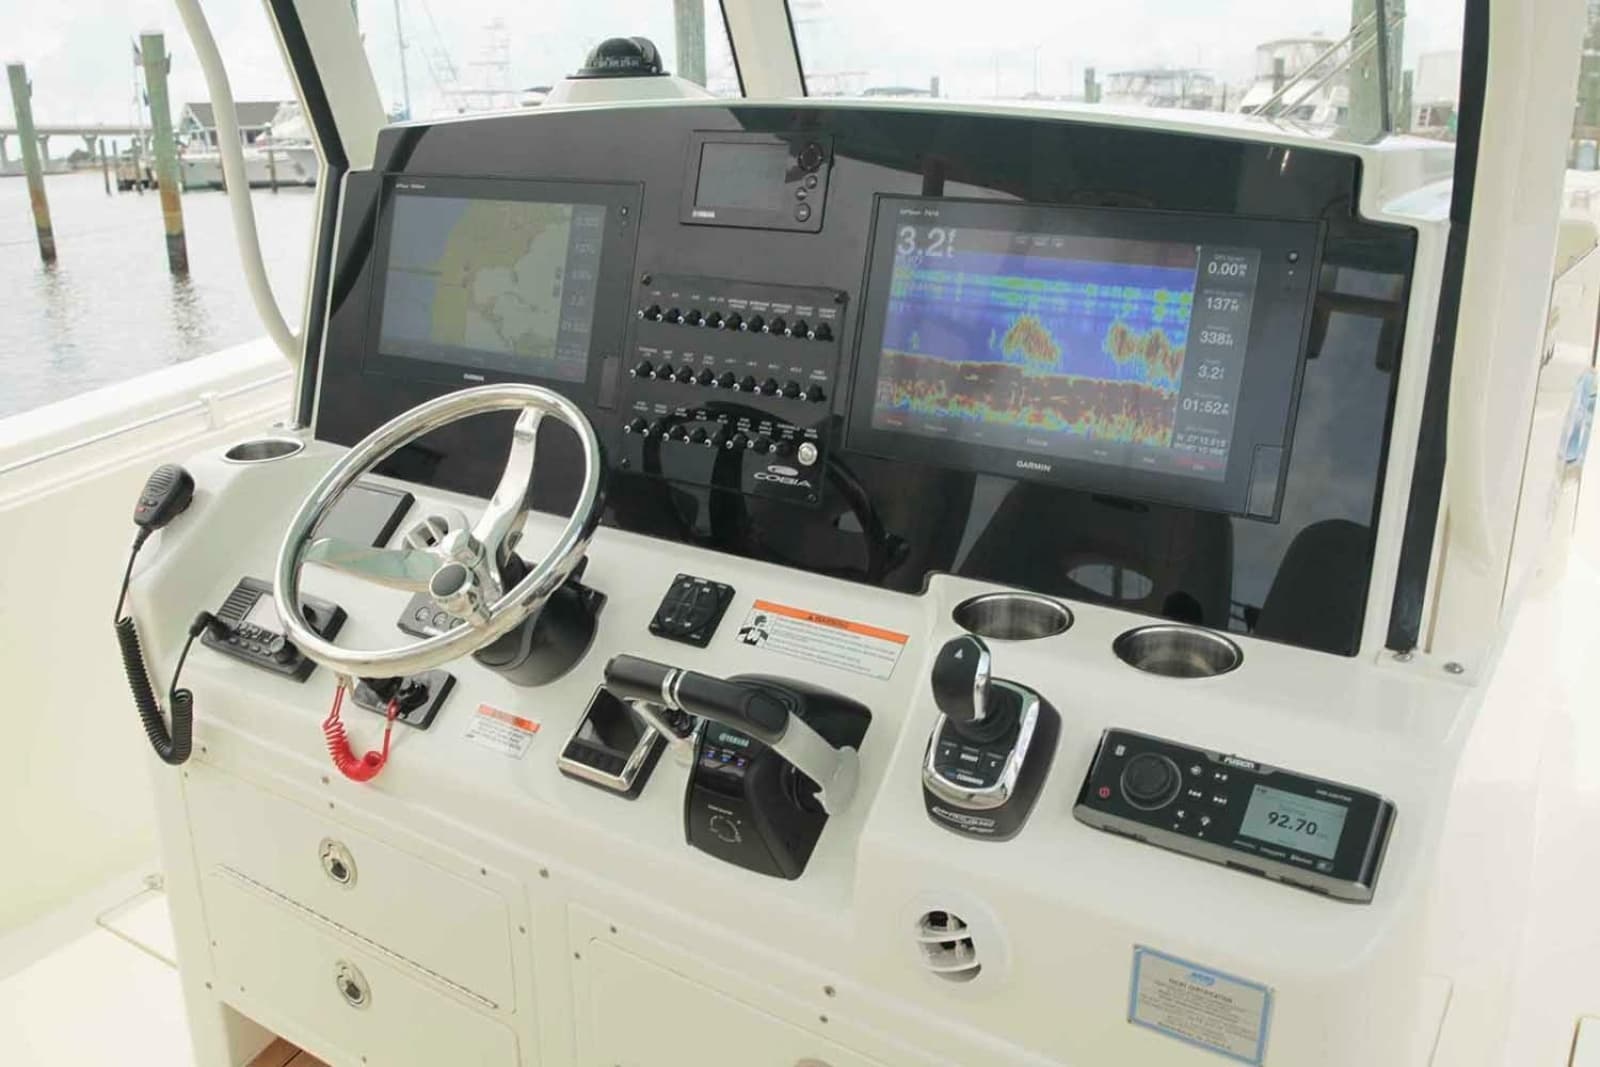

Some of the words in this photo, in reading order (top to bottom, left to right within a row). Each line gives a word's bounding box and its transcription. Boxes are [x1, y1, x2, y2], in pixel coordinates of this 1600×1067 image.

[1207, 297, 1231, 311] 137
[1200, 330, 1226, 345] 338
[1015, 459, 1052, 473] GARMIN
[753, 471, 812, 489] COBIA
[1267, 811, 1318, 836] 92.70
